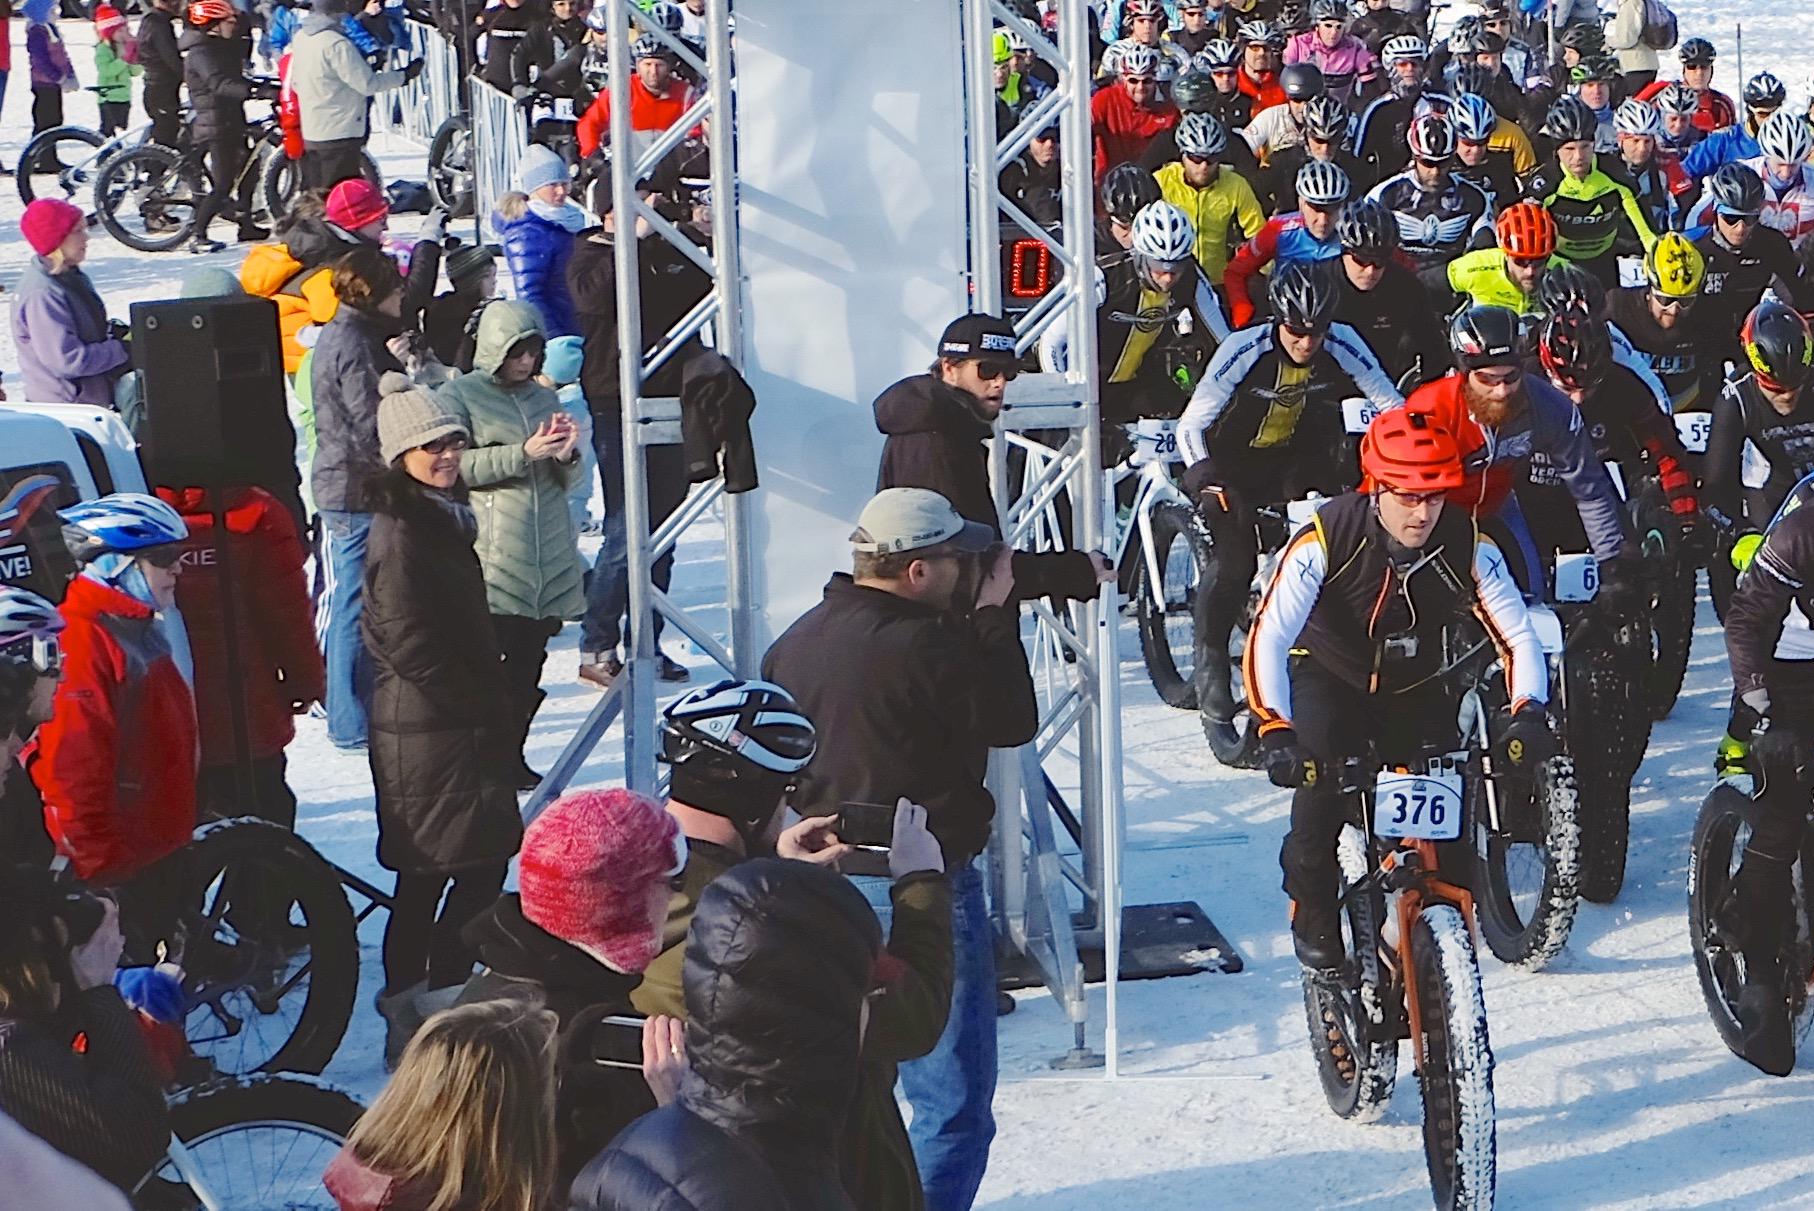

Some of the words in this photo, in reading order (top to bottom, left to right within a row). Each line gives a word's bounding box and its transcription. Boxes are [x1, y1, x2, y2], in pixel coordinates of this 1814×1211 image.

[0, 556, 32, 579] VE!
[1583, 568, 1595, 591] 6
[1392, 793, 1445, 825] 376
